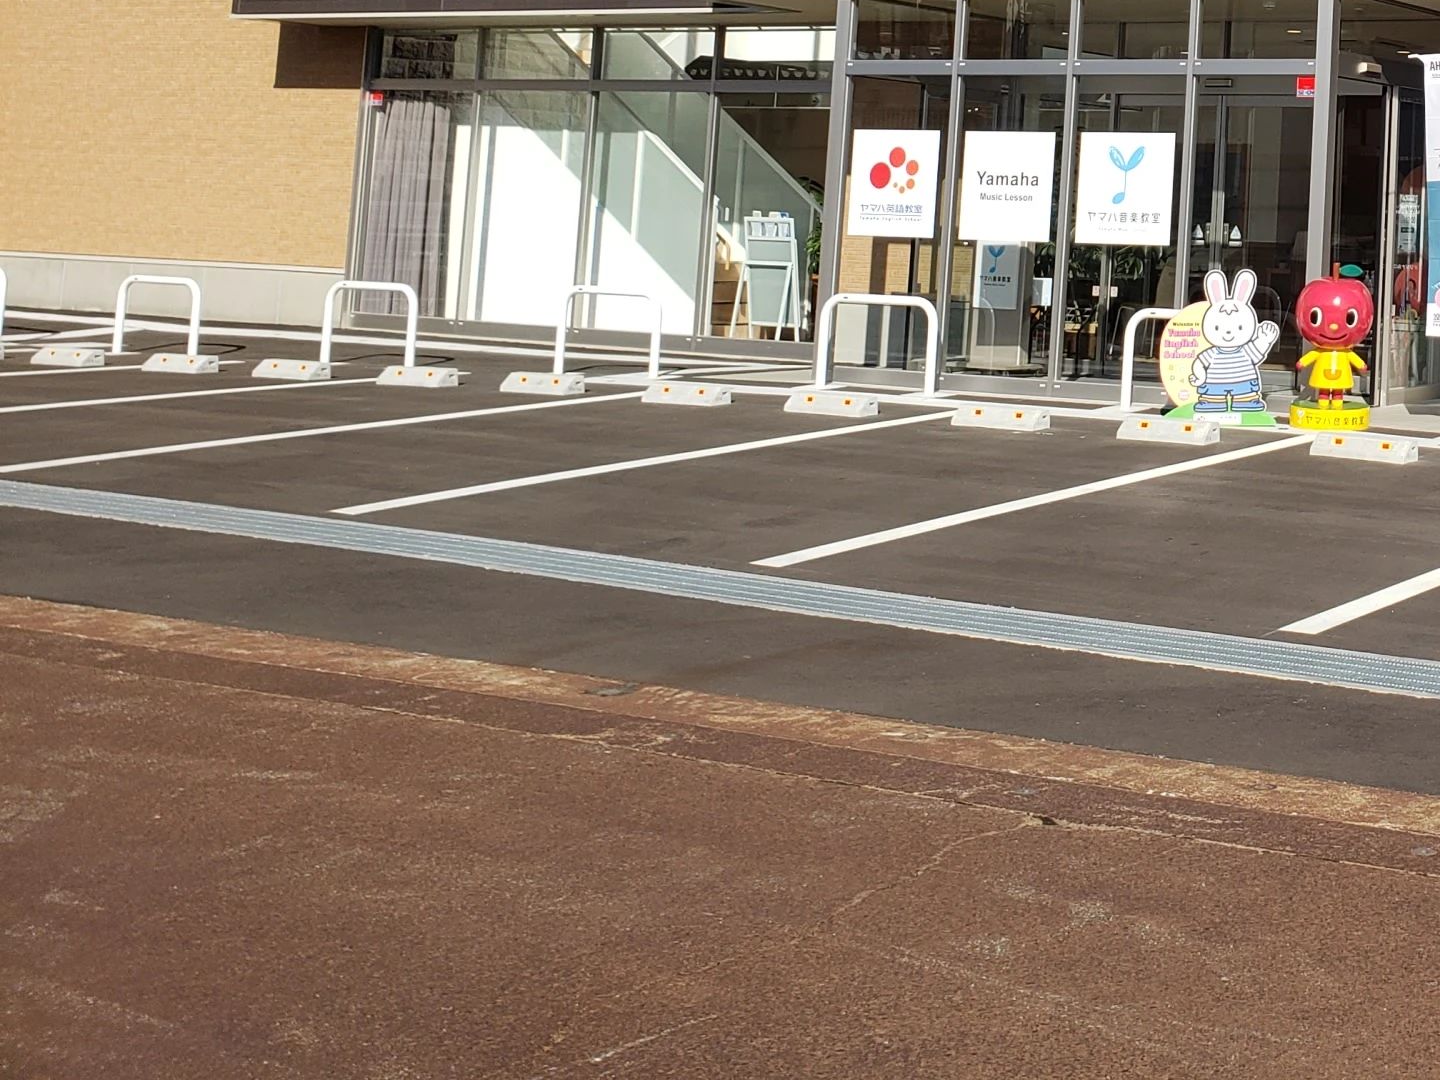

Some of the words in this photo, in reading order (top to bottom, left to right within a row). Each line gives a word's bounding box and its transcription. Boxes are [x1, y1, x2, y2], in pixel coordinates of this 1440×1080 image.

[977, 171, 1039, 187] Yamaha
[980, 192, 1002, 201] Music
[1004, 192, 1033, 202] Lesson
[860, 204, 922, 214] ヤマハ英語教室
[1087, 212, 1161, 224] ヤマハ音楽教室
[1167, 328, 1201, 337] Yamaha
[1163, 339, 1199, 352] English
[1163, 349, 1196, 359] School
